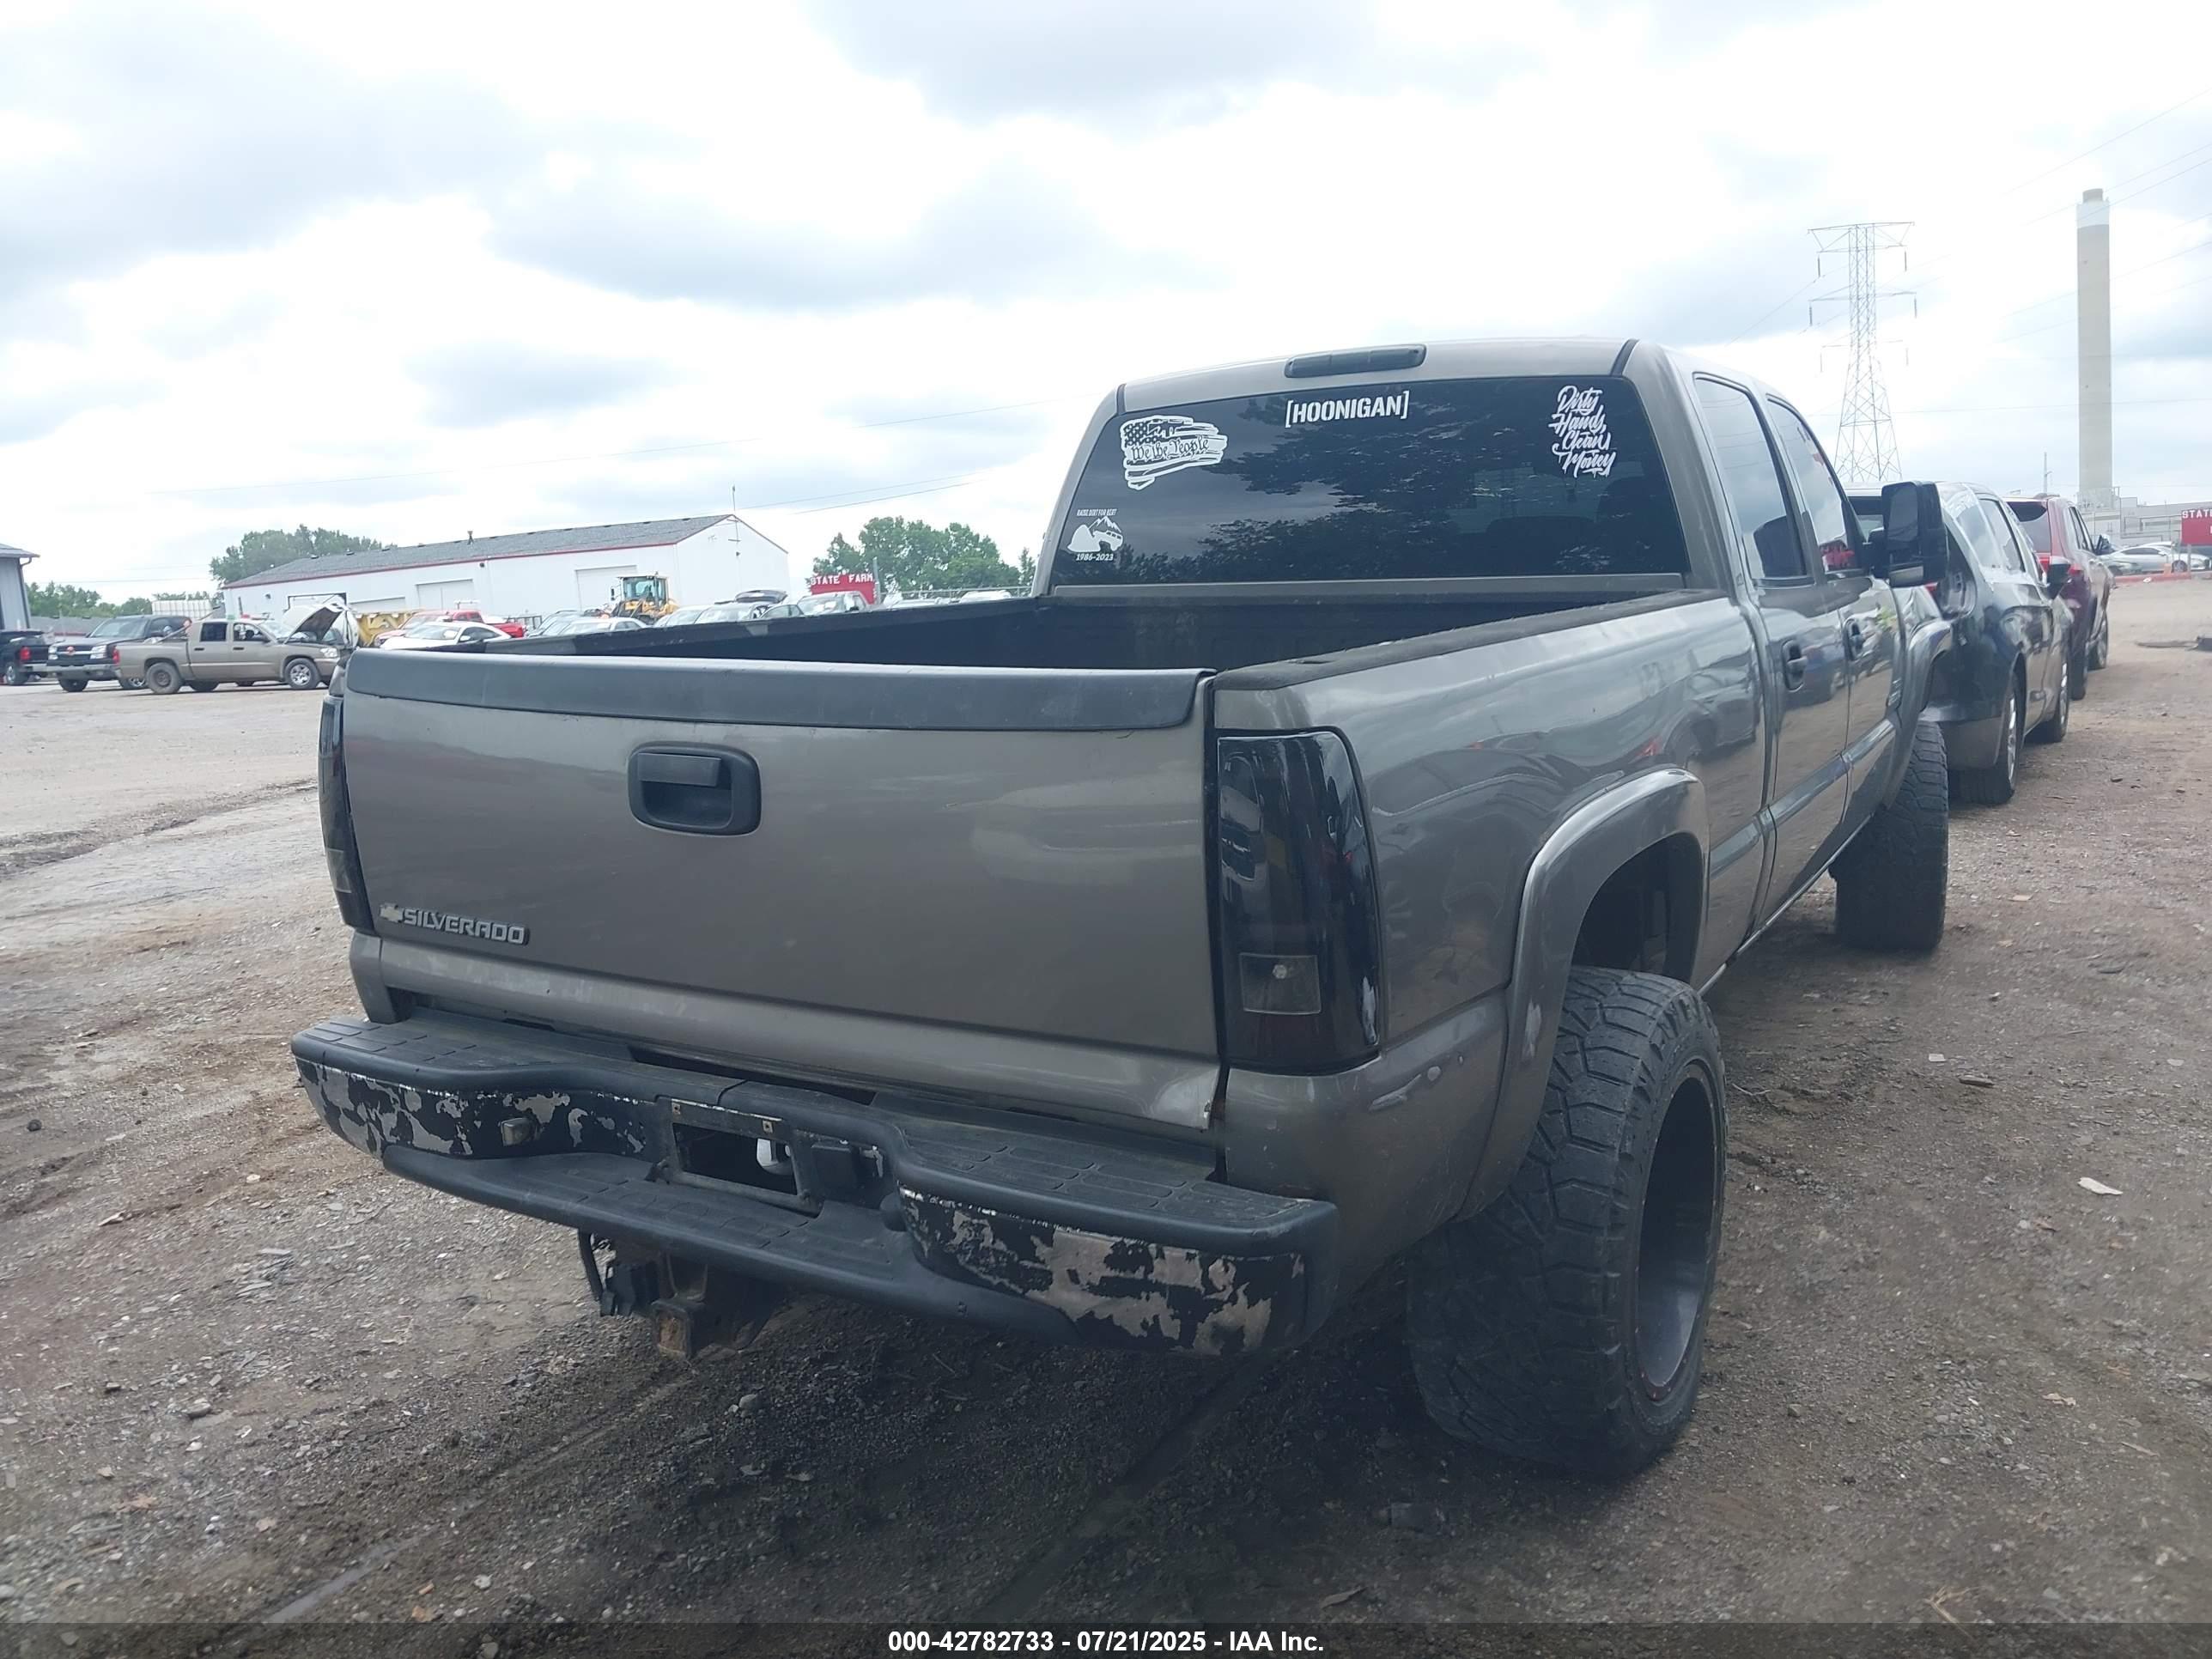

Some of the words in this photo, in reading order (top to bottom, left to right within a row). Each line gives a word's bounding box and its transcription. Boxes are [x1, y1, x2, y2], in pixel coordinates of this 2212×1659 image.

[1557, 385, 1603, 416] Dirty
[1548, 404, 1607, 437] Hands
[1131, 444, 1151, 461] We
[1169, 436, 1209, 459] People
[1562, 430, 1611, 451] Clean
[1552, 449, 1616, 478] Money
[1076, 553, 1115, 562] 1986-2023
[810, 574, 840, 586] STATE
[403, 908, 526, 945] SILVERADO
